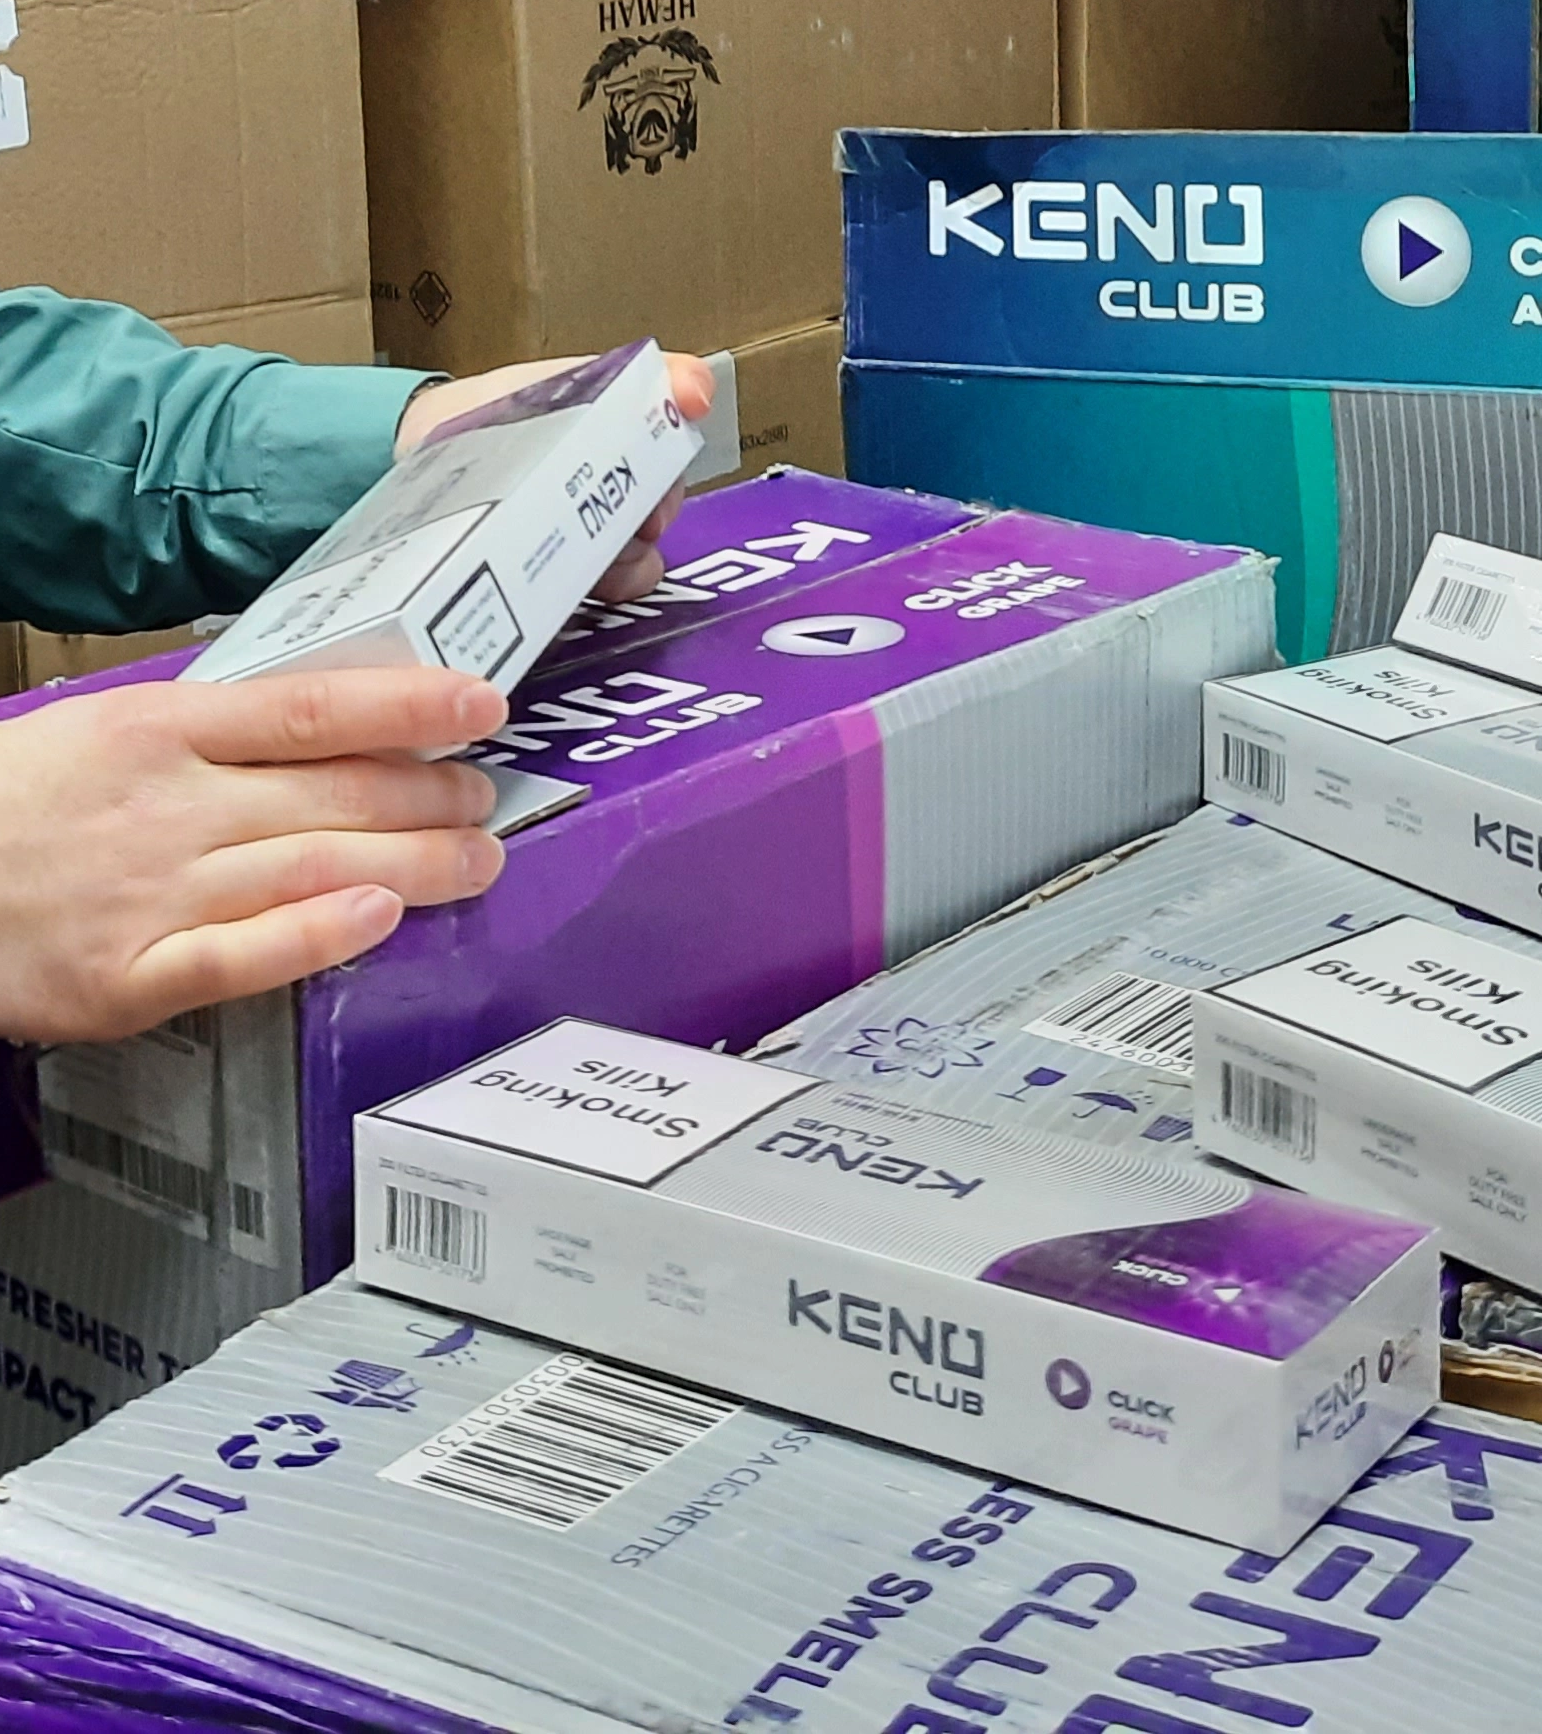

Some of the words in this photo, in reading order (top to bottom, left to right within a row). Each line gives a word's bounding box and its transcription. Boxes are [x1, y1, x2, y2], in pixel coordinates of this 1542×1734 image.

[927, 179, 1265, 265] KENO
[1099, 279, 1265, 323] CLUB
[577, 456, 638, 540] KENO
[904, 560, 1053, 611] CLICK
[958, 574, 1086, 620] GRAPE
[1294, 665, 1450, 724] Smoking
[1374, 667, 1457, 698] Kills
[568, 693, 763, 763] CLUB
[1304, 956, 1530, 1051] Smoking
[1407, 956, 1523, 1010] Kills
[572, 1052, 687, 1100] Kills
[470, 1065, 702, 1143] Smoking
[791, 1115, 896, 1148] CLUB
[755, 1127, 987, 1201] KENO
[1115, 1256, 1191, 1288] CLICK
[787, 1278, 987, 1381] KENO
[888, 1368, 987, 1417] CLUB
[1107, 1387, 1177, 1425] CLICK
[1293, 1354, 1369, 1454] KENO
[1107, 1415, 1170, 1446] GRAPE
[609, 1466, 764, 1573] CIGARETTES
